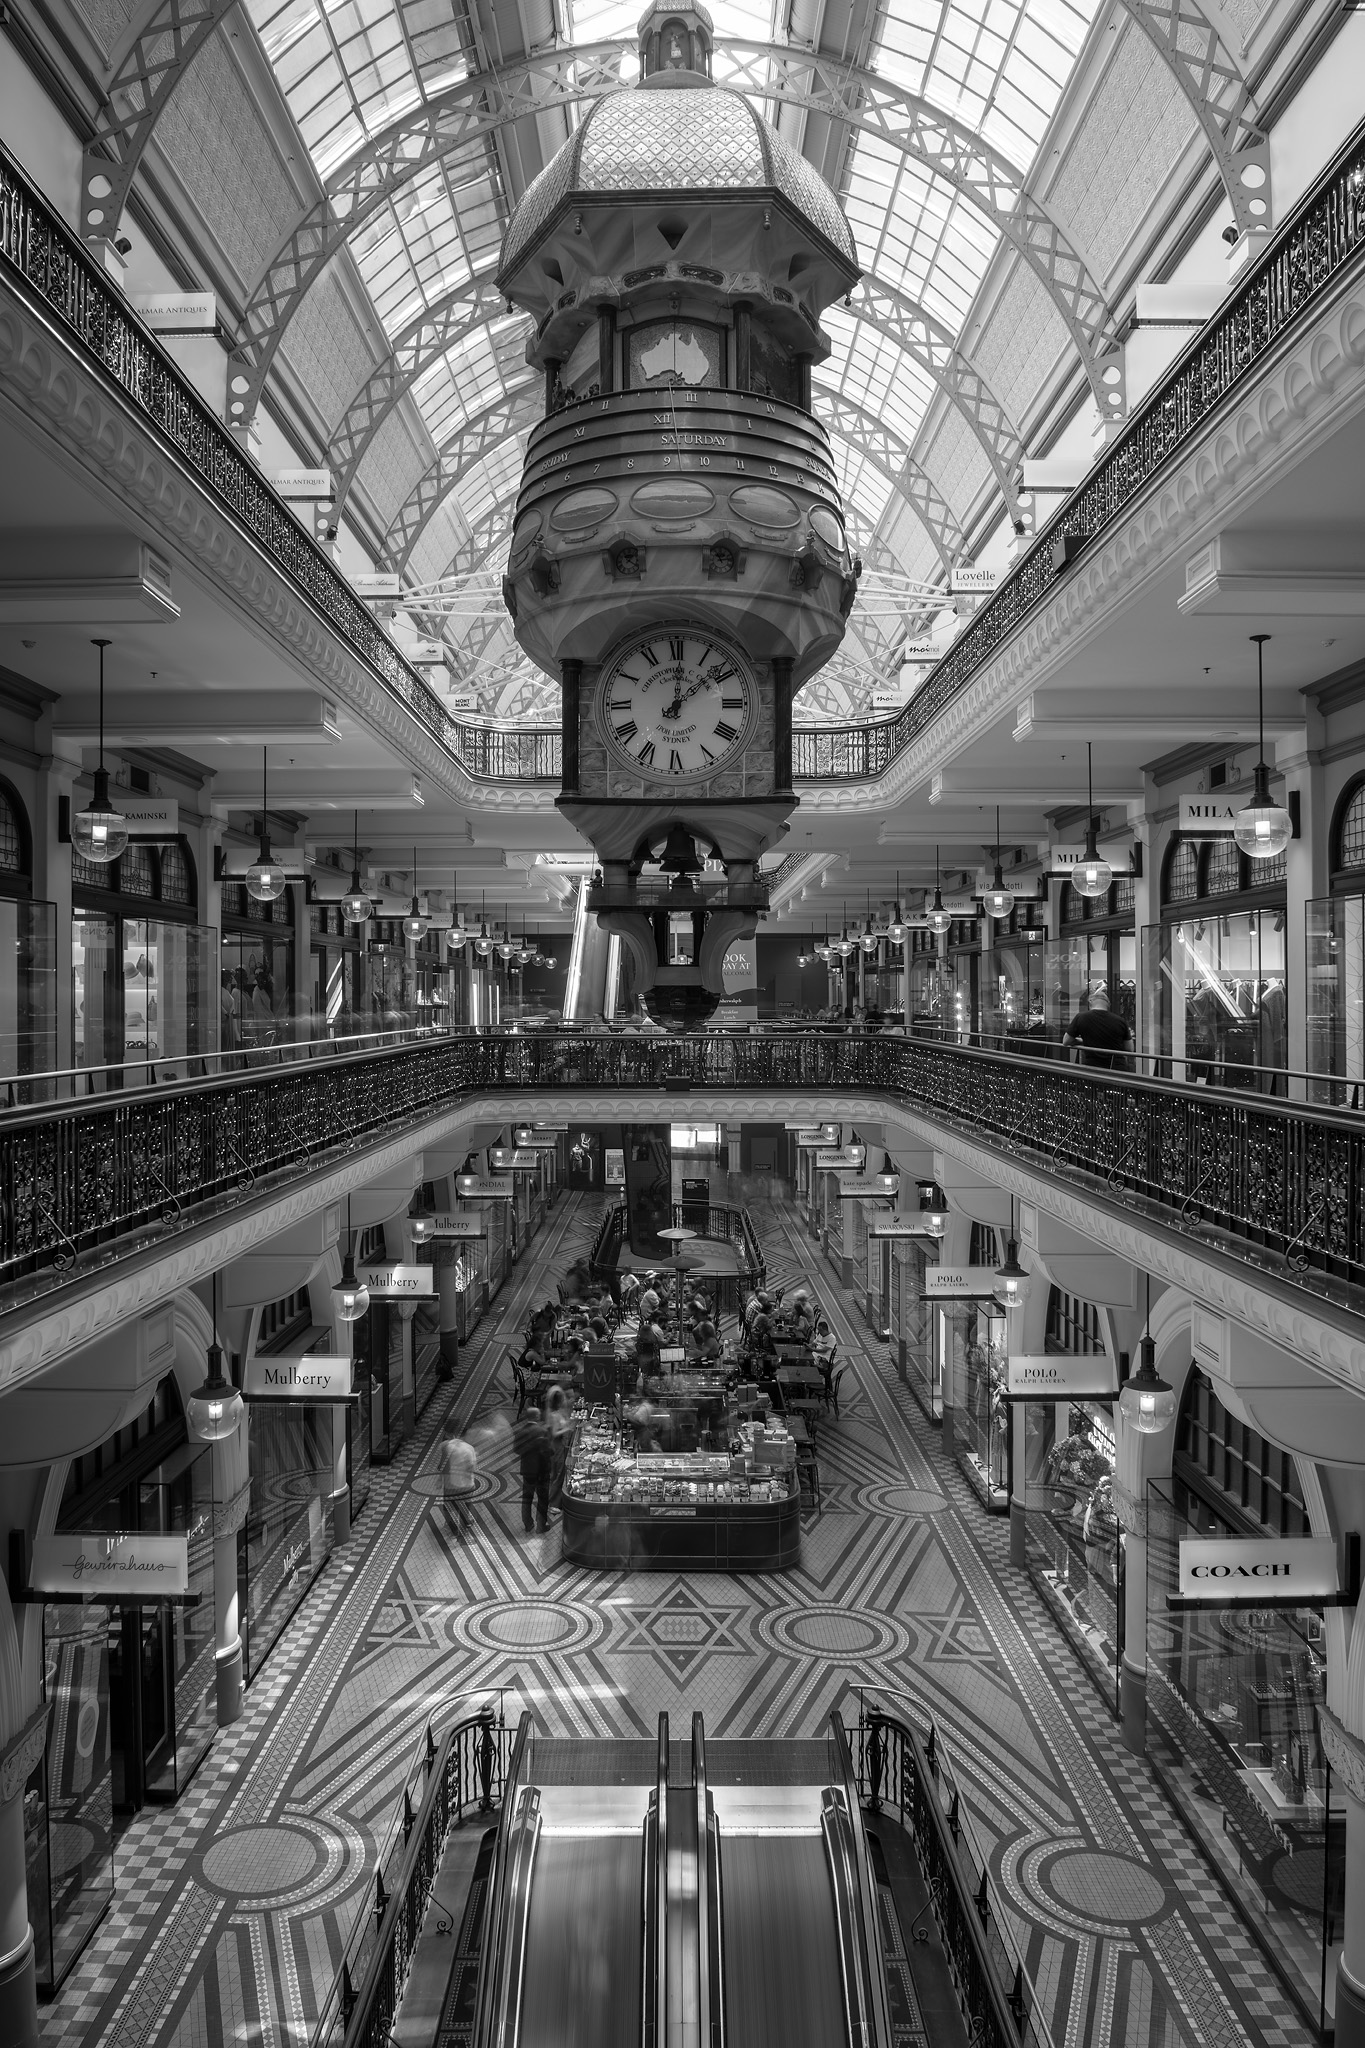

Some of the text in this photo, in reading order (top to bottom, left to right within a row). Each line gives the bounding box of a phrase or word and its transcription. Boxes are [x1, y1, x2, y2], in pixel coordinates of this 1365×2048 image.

[166, 306, 208, 314] ANTIQUES
[685, 393, 698, 403] III
[601, 400, 610, 410] II
[766, 403, 776, 414] IV
[653, 414, 671, 424] XII
[573, 426, 586, 439] XI
[661, 434, 728, 446] SATURDAY
[627, 458, 635, 469] 8
[662, 456, 671, 466] 9
[699, 456, 710, 466] 10
[736, 460, 745, 470] 11
[593, 463, 600, 474] 7
[768, 465, 779, 477] 12
[564, 472, 570, 482] 6
[668, 640, 685, 662] XII
[640, 647, 662, 670] XI
[697, 648, 712, 668] I
[618, 669, 641, 686] X
[722, 698, 743, 711] III
[672, 724, 697, 736] LIMITED
[662, 736, 691, 744] SYDNEY
[638, 740, 656, 766] VII
[126, 812, 167, 820] KAMINSKI
[1058, 854, 1082, 863] MIL
[979, 882, 990, 890] via
[739, 962, 750, 970] AT
[368, 1274, 419, 1289] Mulberry
[937, 1275, 962, 1283] POLO
[264, 1366, 332, 1389] Mulberry
[1024, 1368, 1058, 1378] POLO
[1190, 1563, 1292, 1578] COACH
